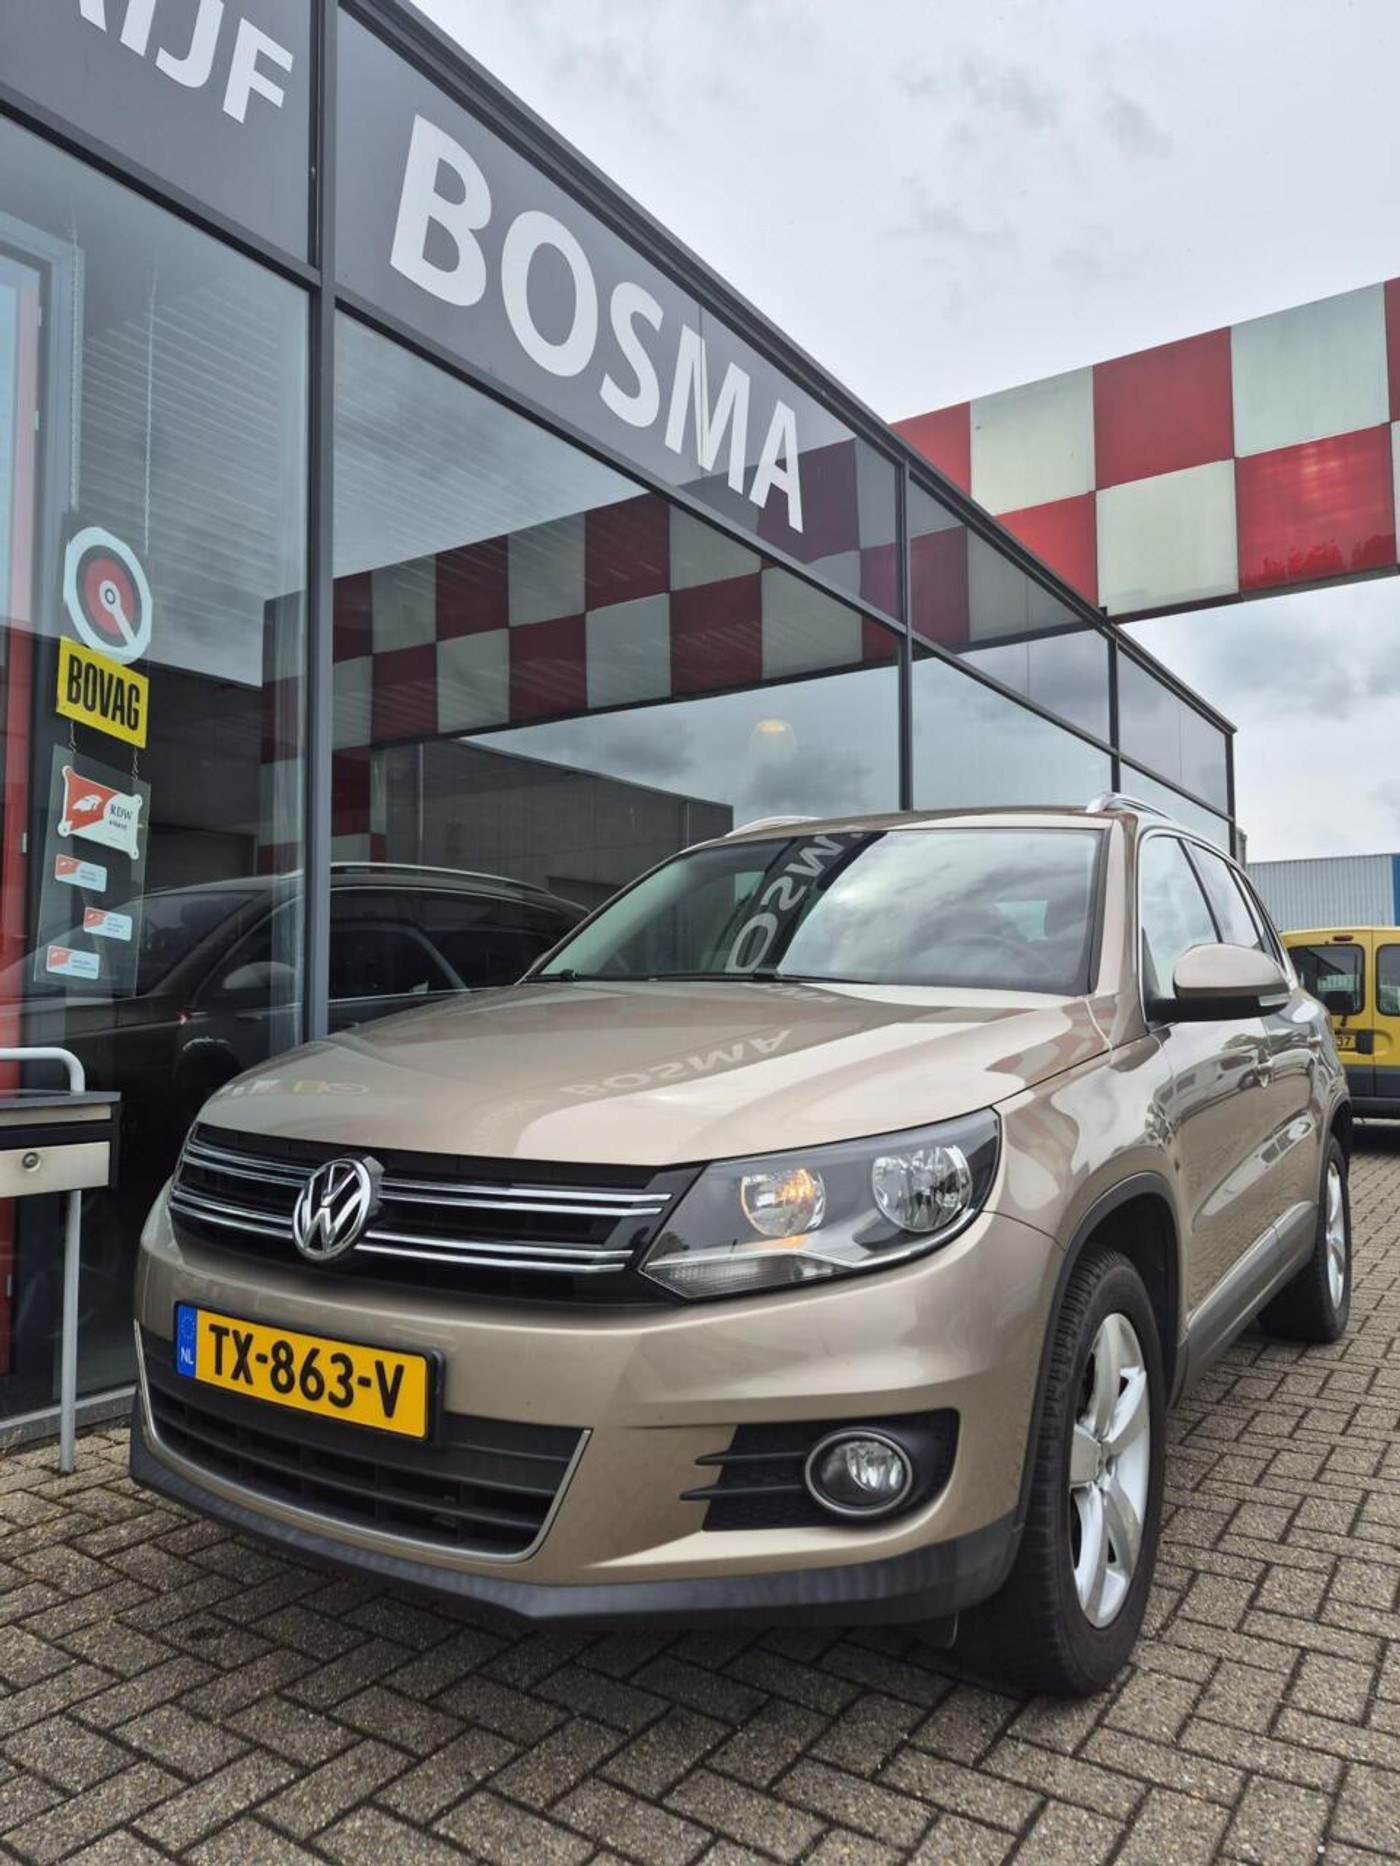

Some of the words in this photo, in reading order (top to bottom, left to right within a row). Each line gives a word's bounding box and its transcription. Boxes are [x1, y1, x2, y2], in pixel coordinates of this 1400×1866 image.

[79, 0, 293, 124] JF
[390, 114, 803, 533] BOSMA
[66, 653, 141, 732] BOVAG
[110, 804, 133, 821] RDW
[181, 1348, 194, 1366] NL
[208, 1323, 405, 1419] TX-863-V
